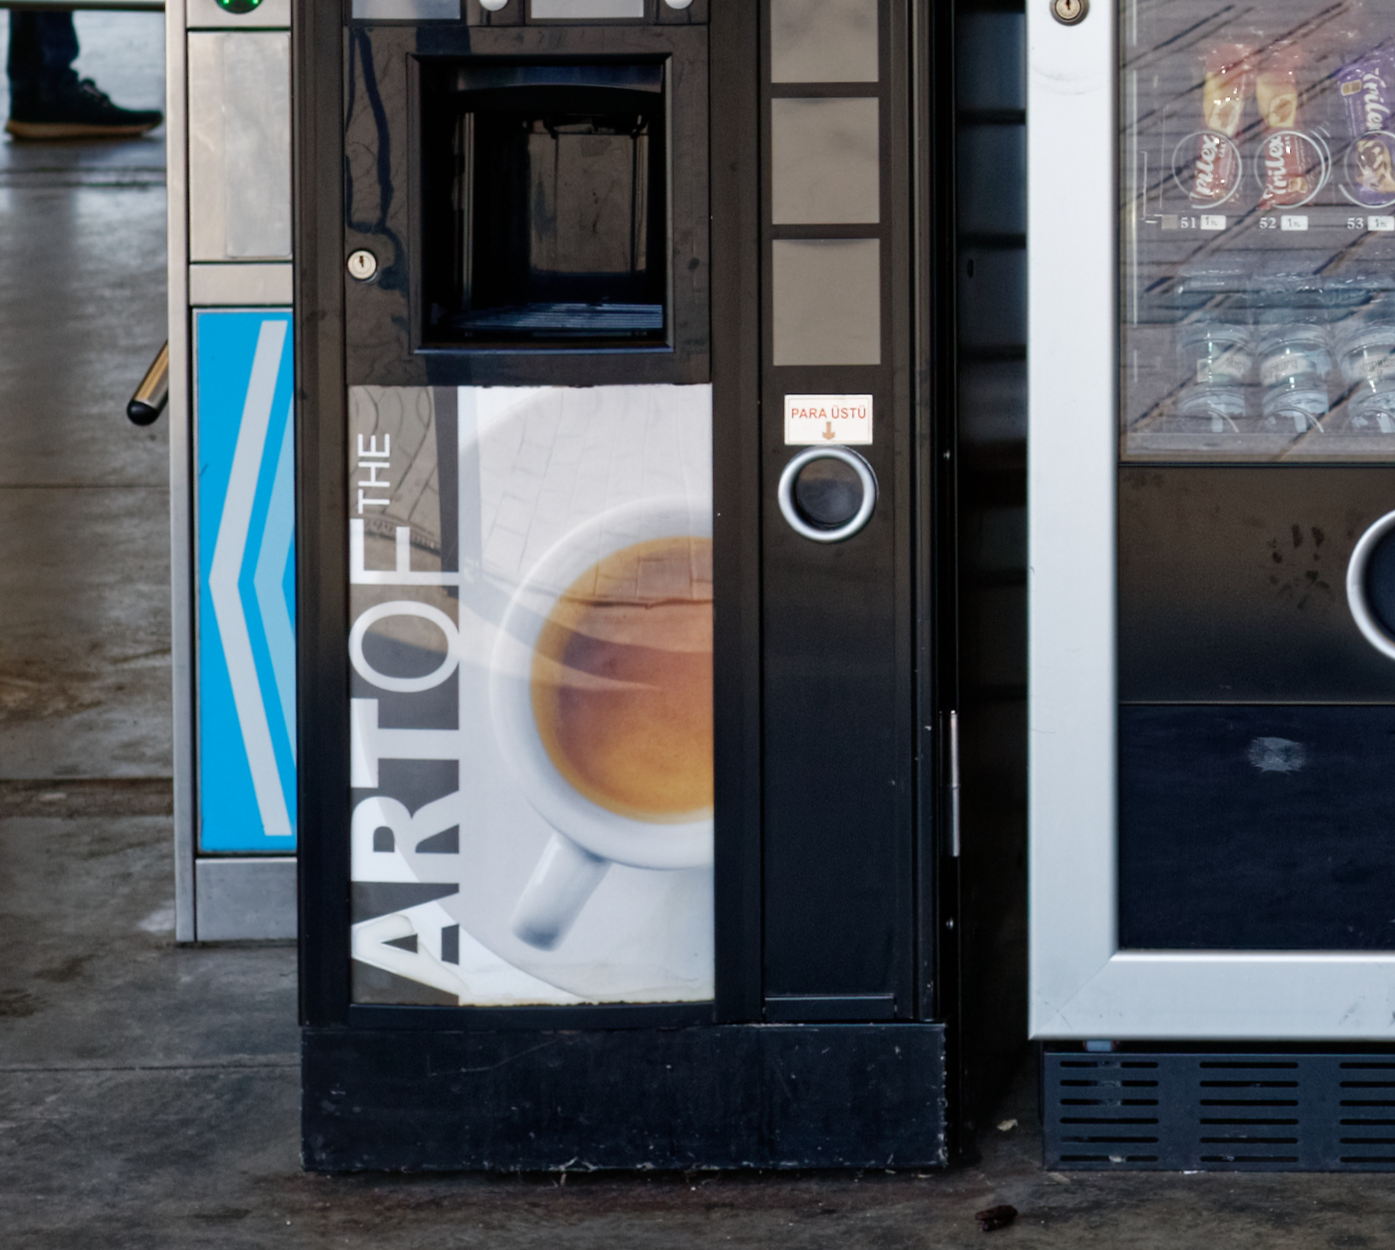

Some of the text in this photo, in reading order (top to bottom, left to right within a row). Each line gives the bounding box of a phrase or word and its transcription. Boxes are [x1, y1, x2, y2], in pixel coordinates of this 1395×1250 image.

[1181, 218, 1196, 229] 51
[791, 404, 867, 420] PARA ÜSTÜ
[358, 433, 390, 513] THE
